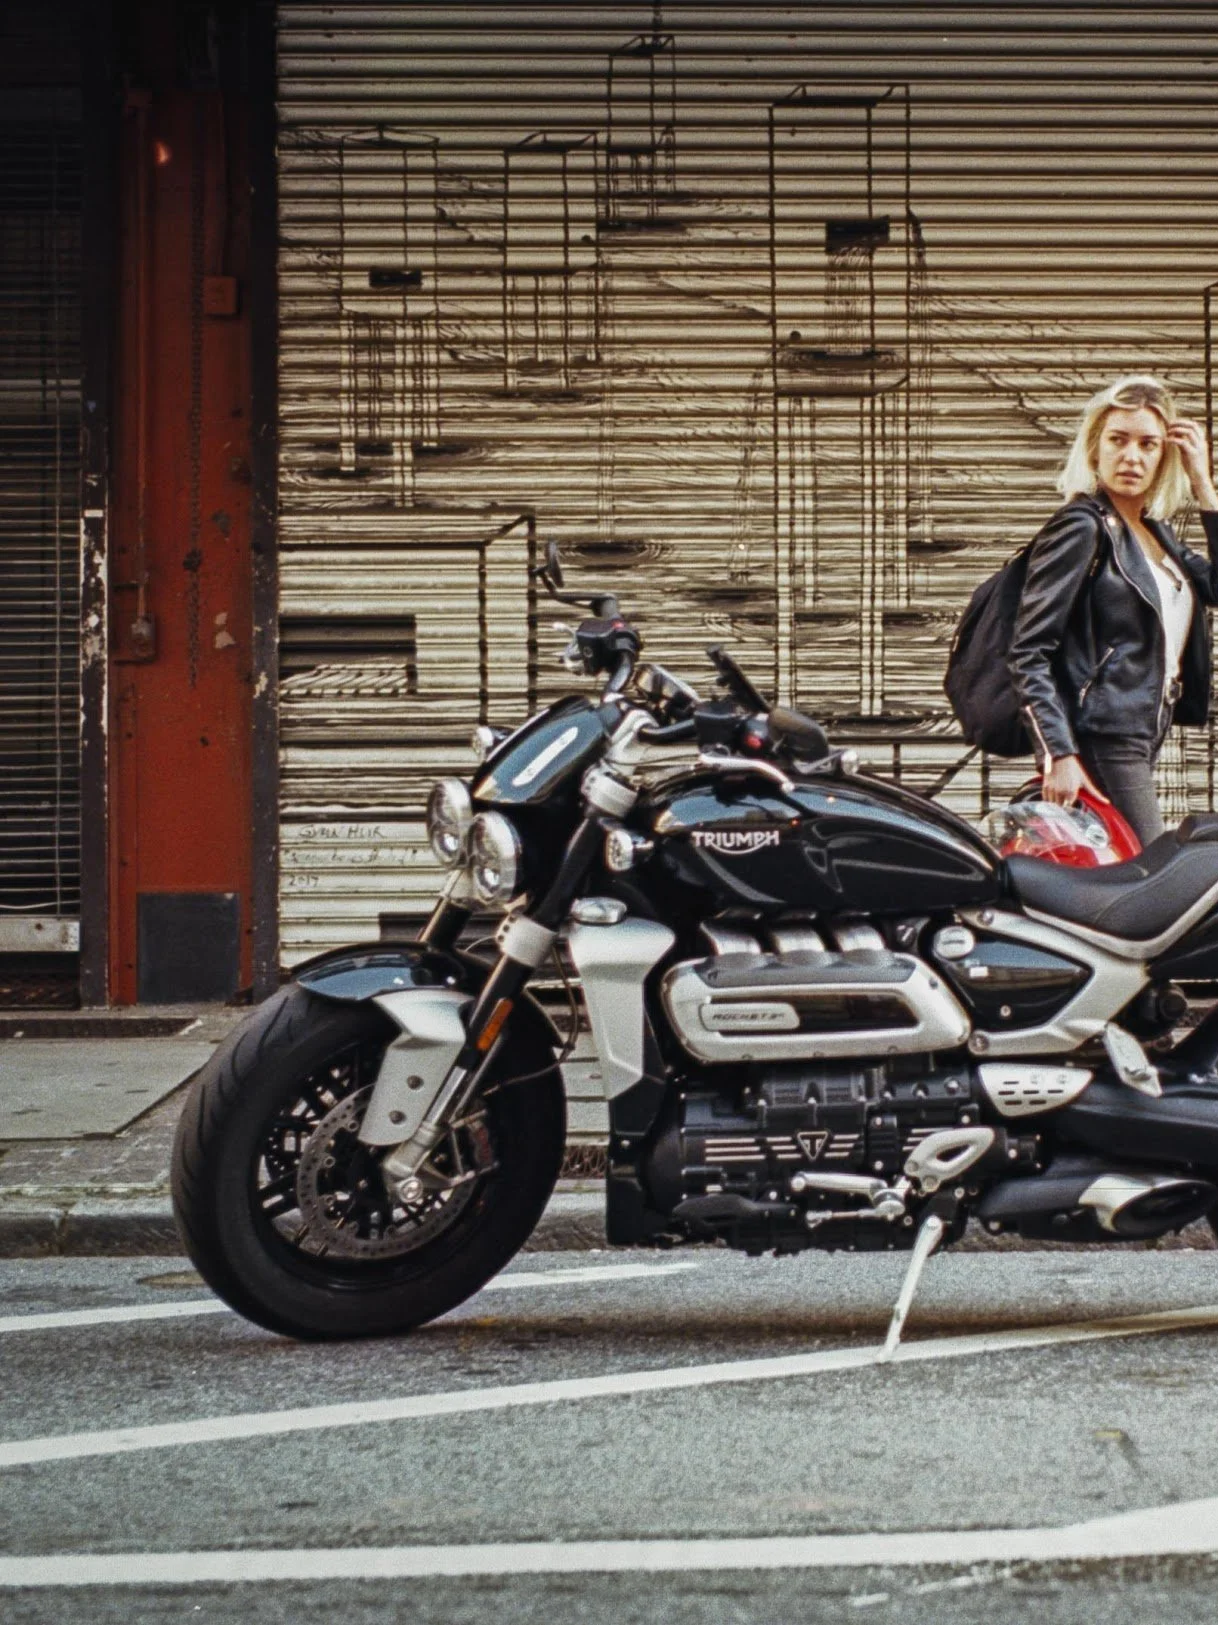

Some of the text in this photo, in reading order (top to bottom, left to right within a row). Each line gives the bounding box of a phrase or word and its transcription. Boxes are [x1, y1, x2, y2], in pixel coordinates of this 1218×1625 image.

[692, 831, 780, 853] TRIUMPH
[289, 874, 320, 887] 2017
[712, 1012, 768, 1021] ROCKET
